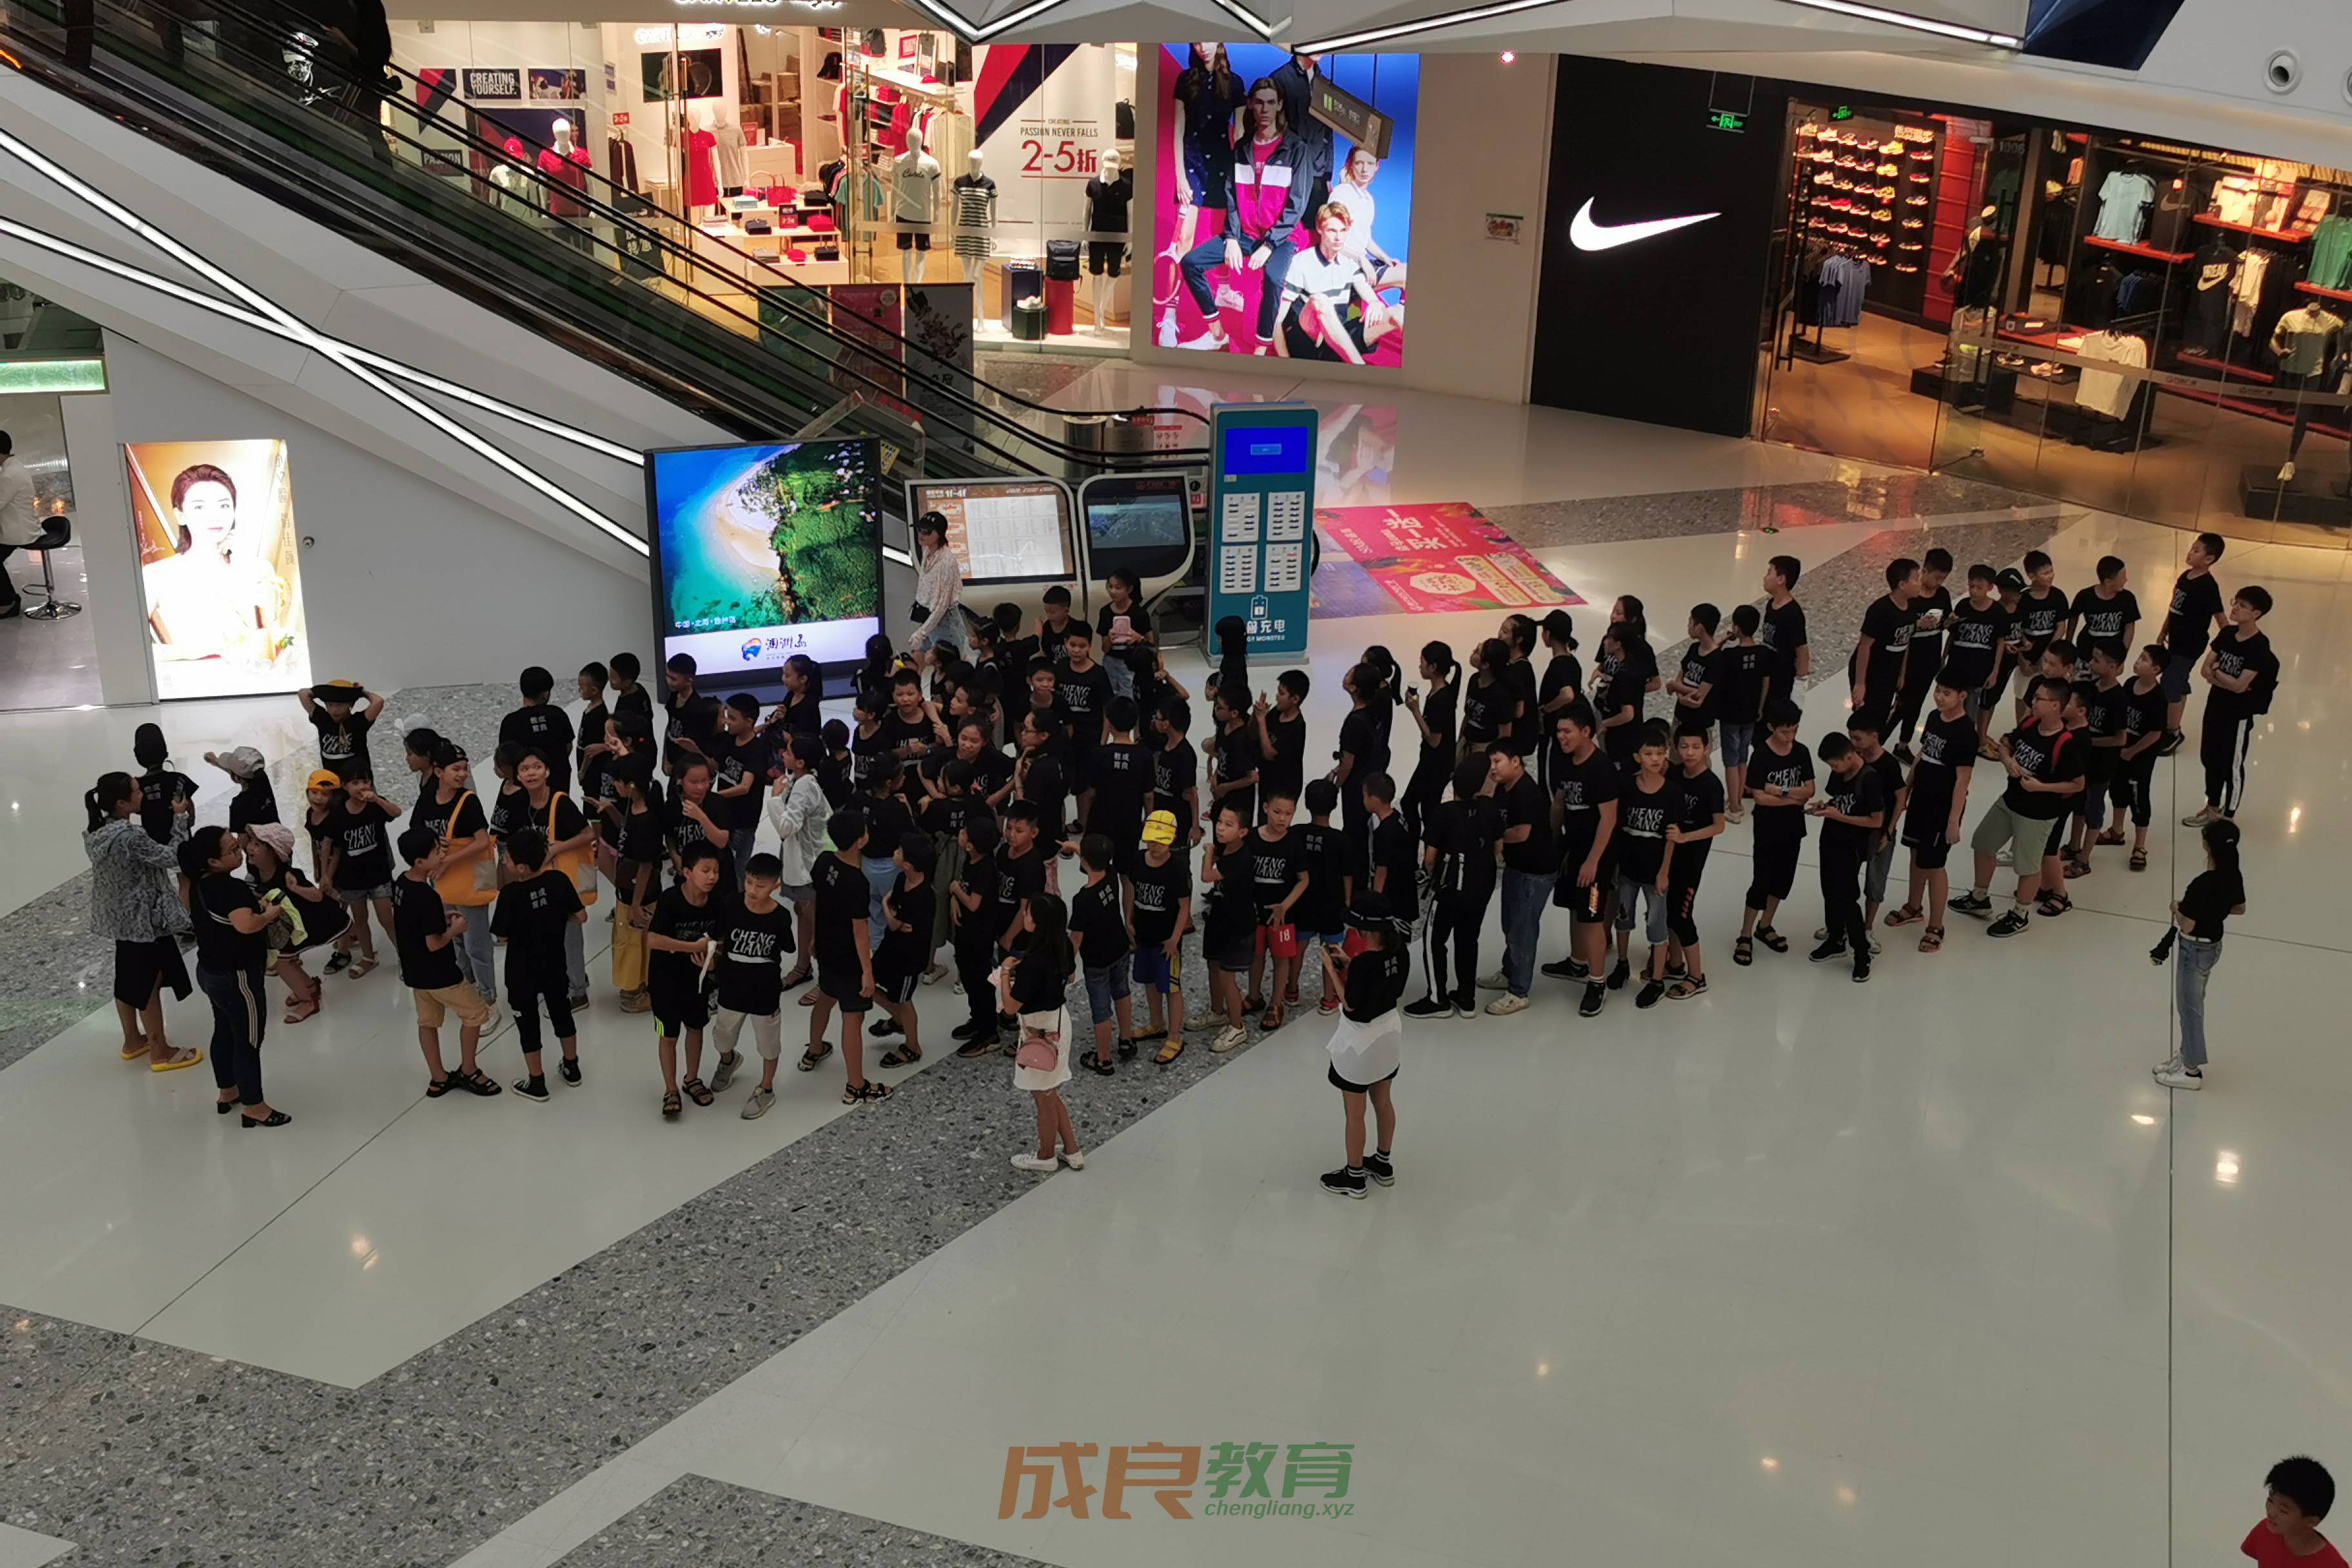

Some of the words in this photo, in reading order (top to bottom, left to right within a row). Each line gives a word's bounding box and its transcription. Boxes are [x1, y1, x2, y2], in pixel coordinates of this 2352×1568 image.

[470, 72, 514, 84] CREATING
[471, 83, 517, 95] YOURSELF.
[1021, 127, 1050, 137] PASSION
[1052, 128, 1076, 137] NEVER
[1077, 128, 1099, 138] FALLS
[1021, 139, 1097, 173] 2-5折
[730, 928, 776, 946] CHENG
[1279, 928, 1290, 943] 18
[732, 940, 772, 956] LIANG
